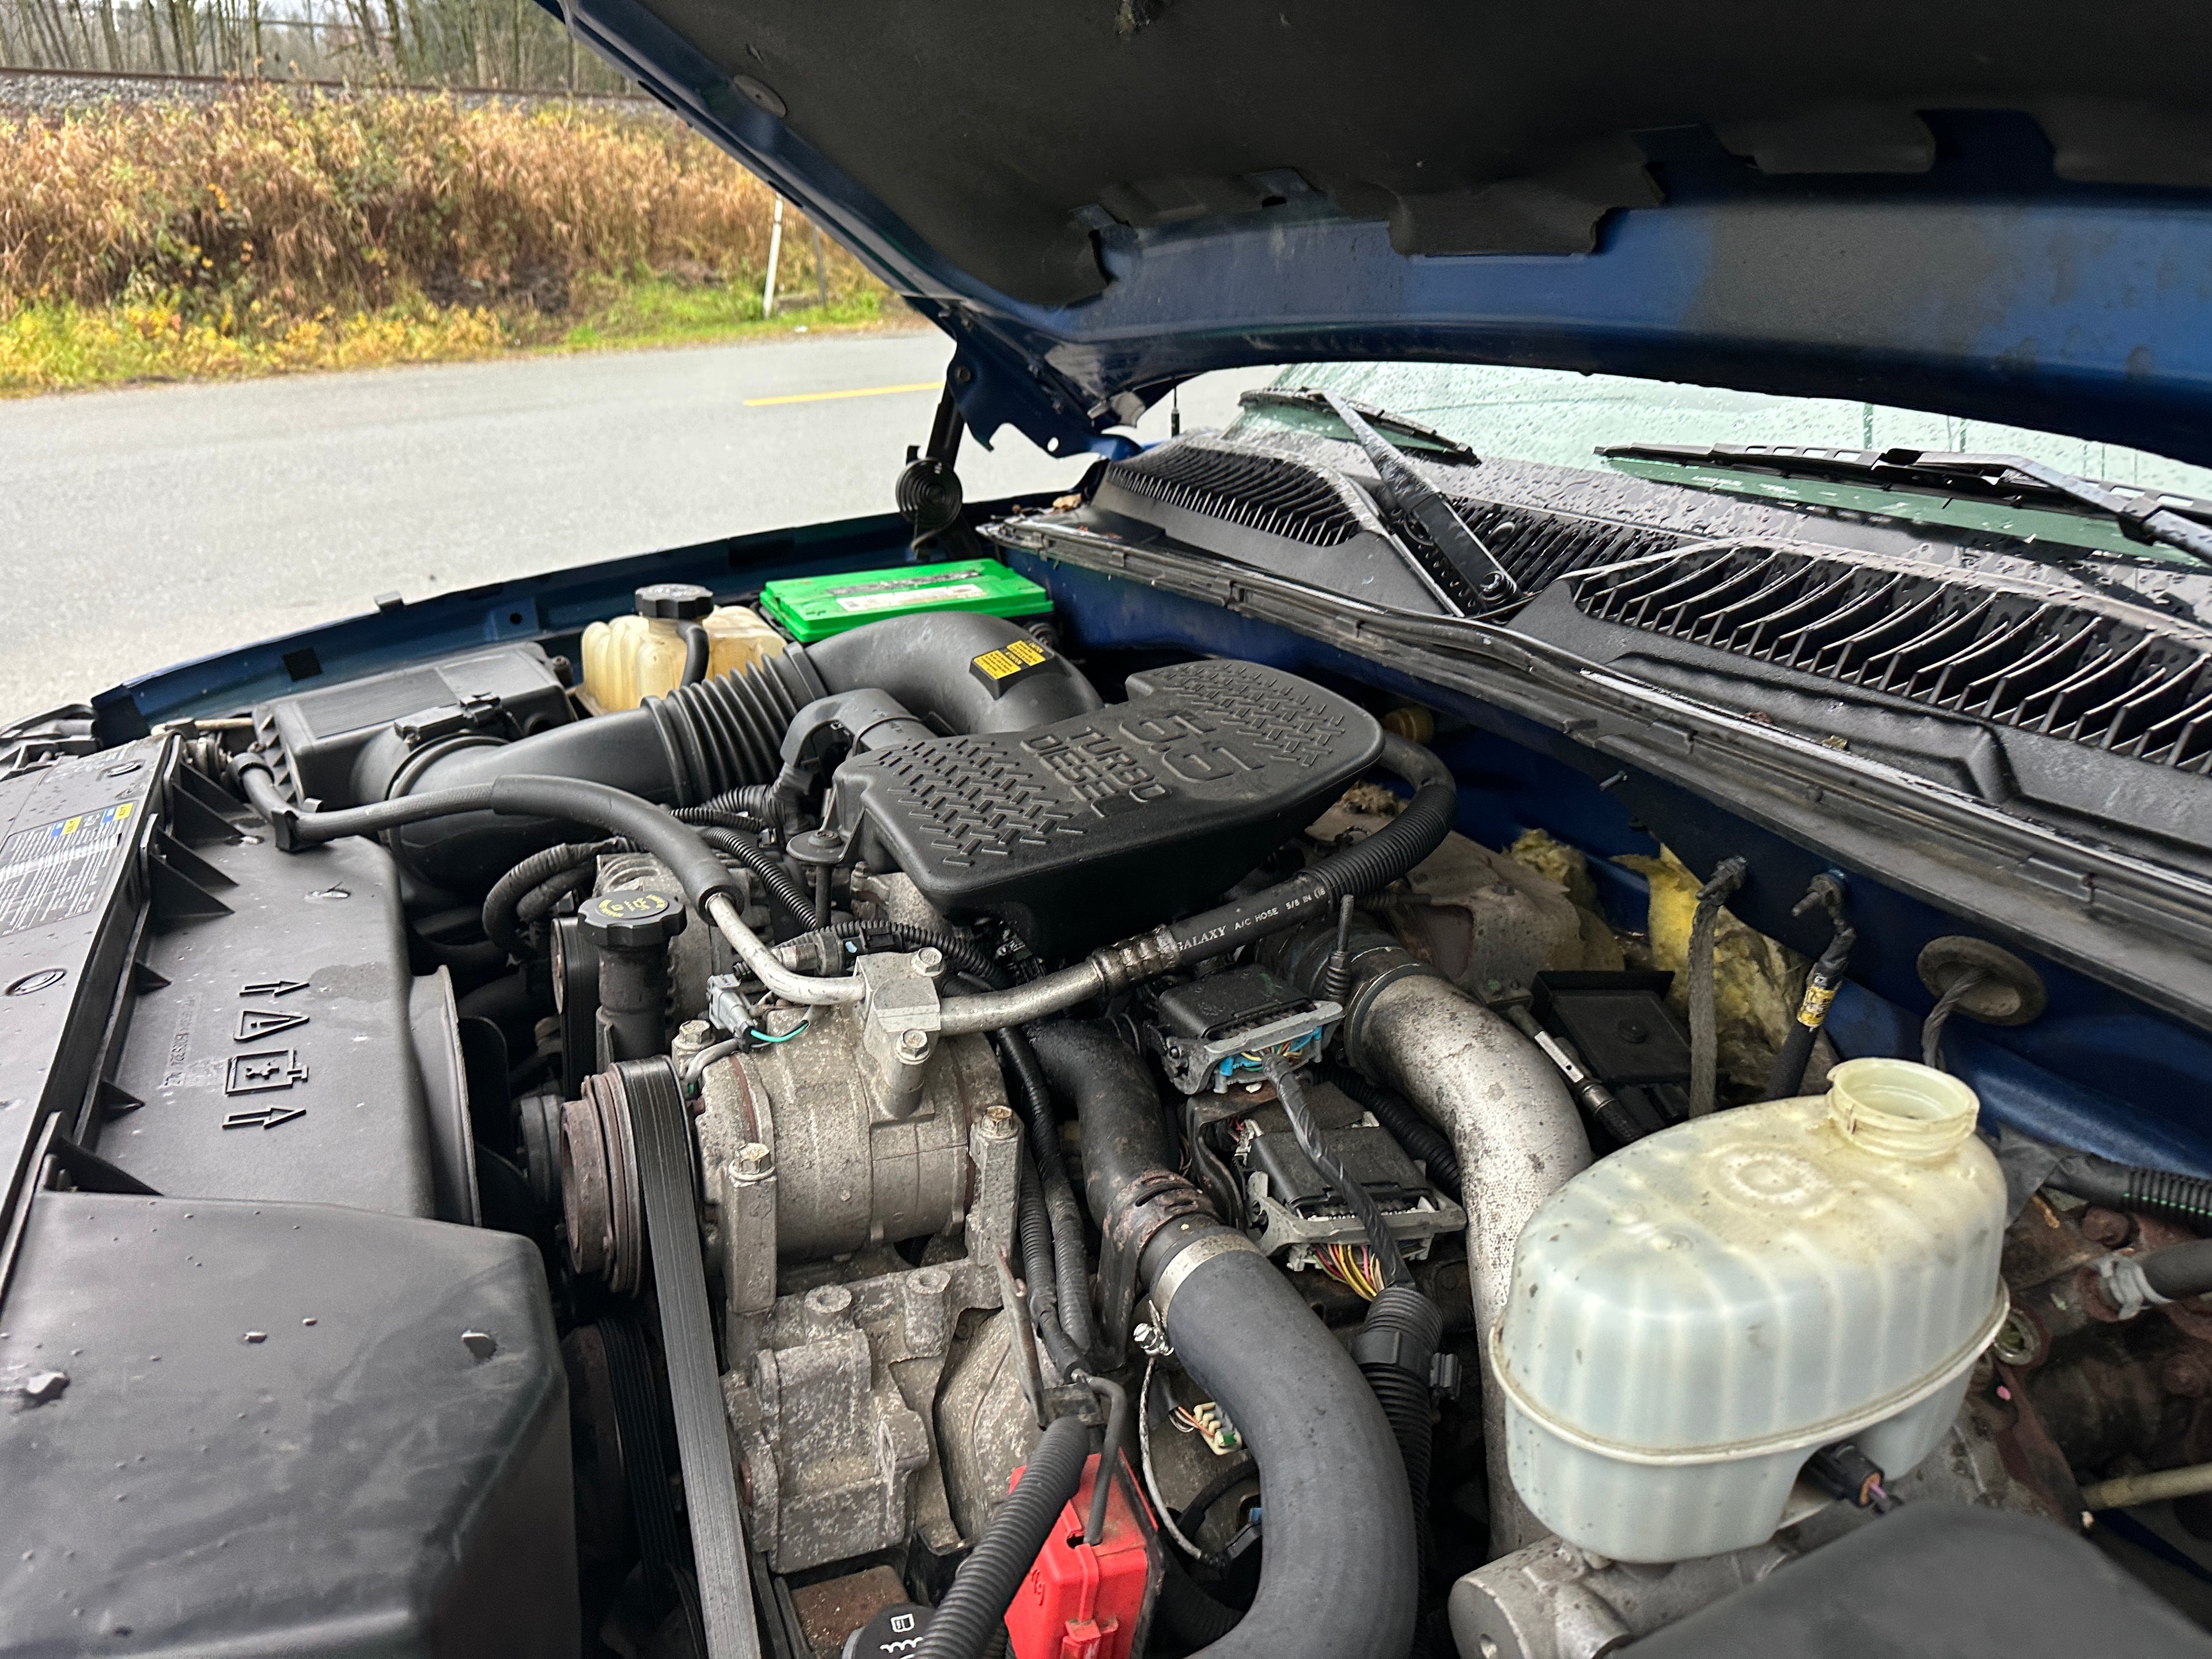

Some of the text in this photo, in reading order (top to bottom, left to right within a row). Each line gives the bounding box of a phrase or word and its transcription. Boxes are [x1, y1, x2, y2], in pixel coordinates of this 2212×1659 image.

[1020, 734, 1119, 817] DIESEL
[1066, 726, 1172, 802] TURBO
[1234, 918, 1252, 930] A/C
[1255, 907, 1279, 922] HOSE
[1285, 899, 1300, 910] 5/8
